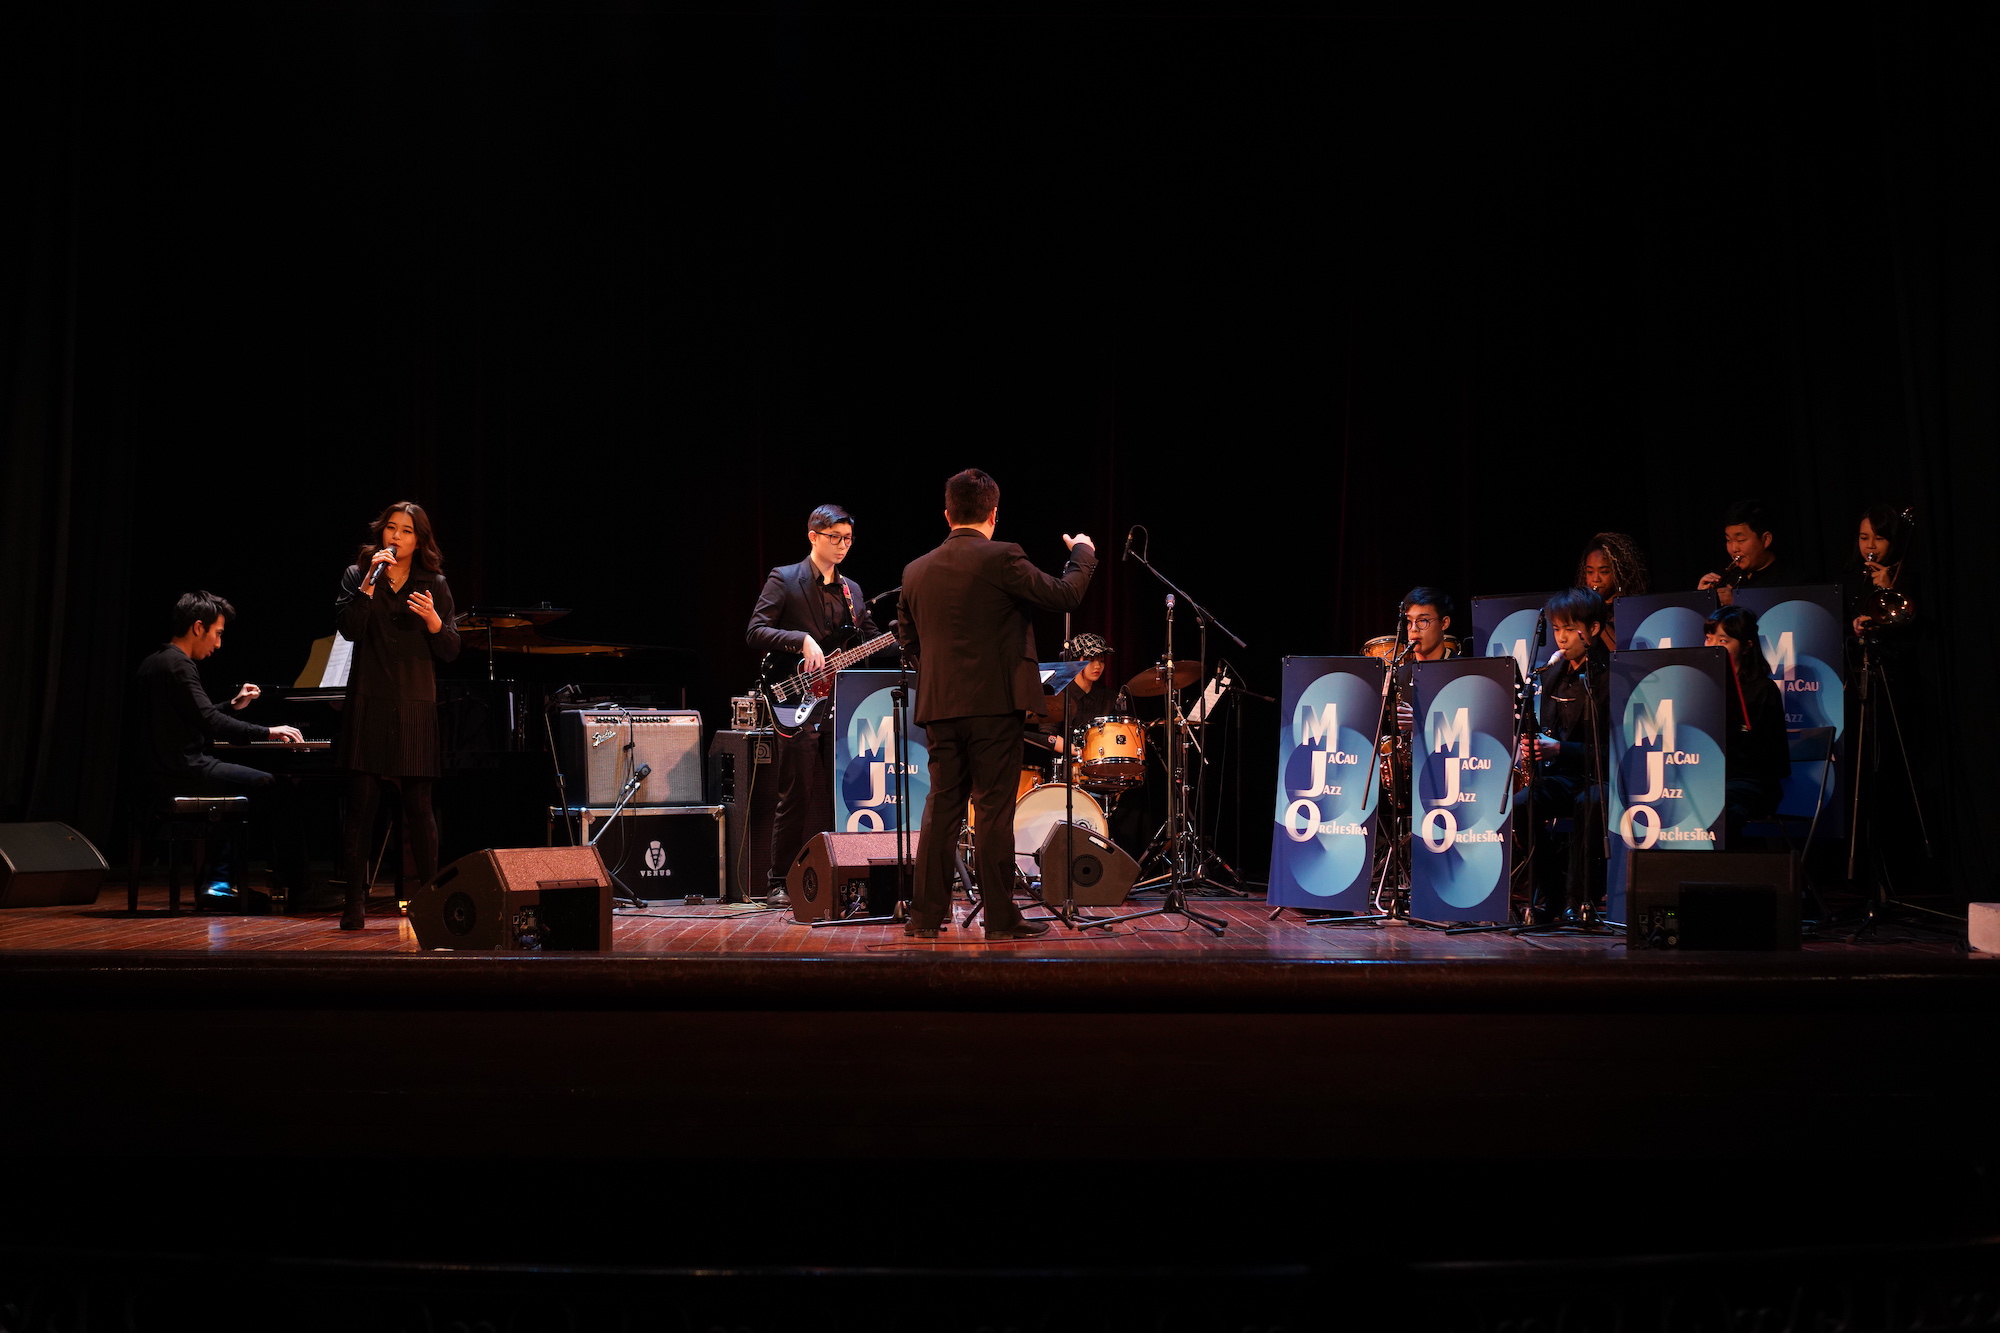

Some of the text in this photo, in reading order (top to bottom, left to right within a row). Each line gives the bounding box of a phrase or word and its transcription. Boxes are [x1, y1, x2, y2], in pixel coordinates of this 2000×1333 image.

[1301, 703, 1359, 765] MACAU
[1433, 707, 1492, 771] MACAU
[1633, 699, 1700, 765] MACAU
[1295, 751, 1342, 798] JAZZ
[1431, 757, 1477, 807] JAZZ
[1628, 751, 1684, 802] JAZZ
[639, 869, 672, 877] VENUS
